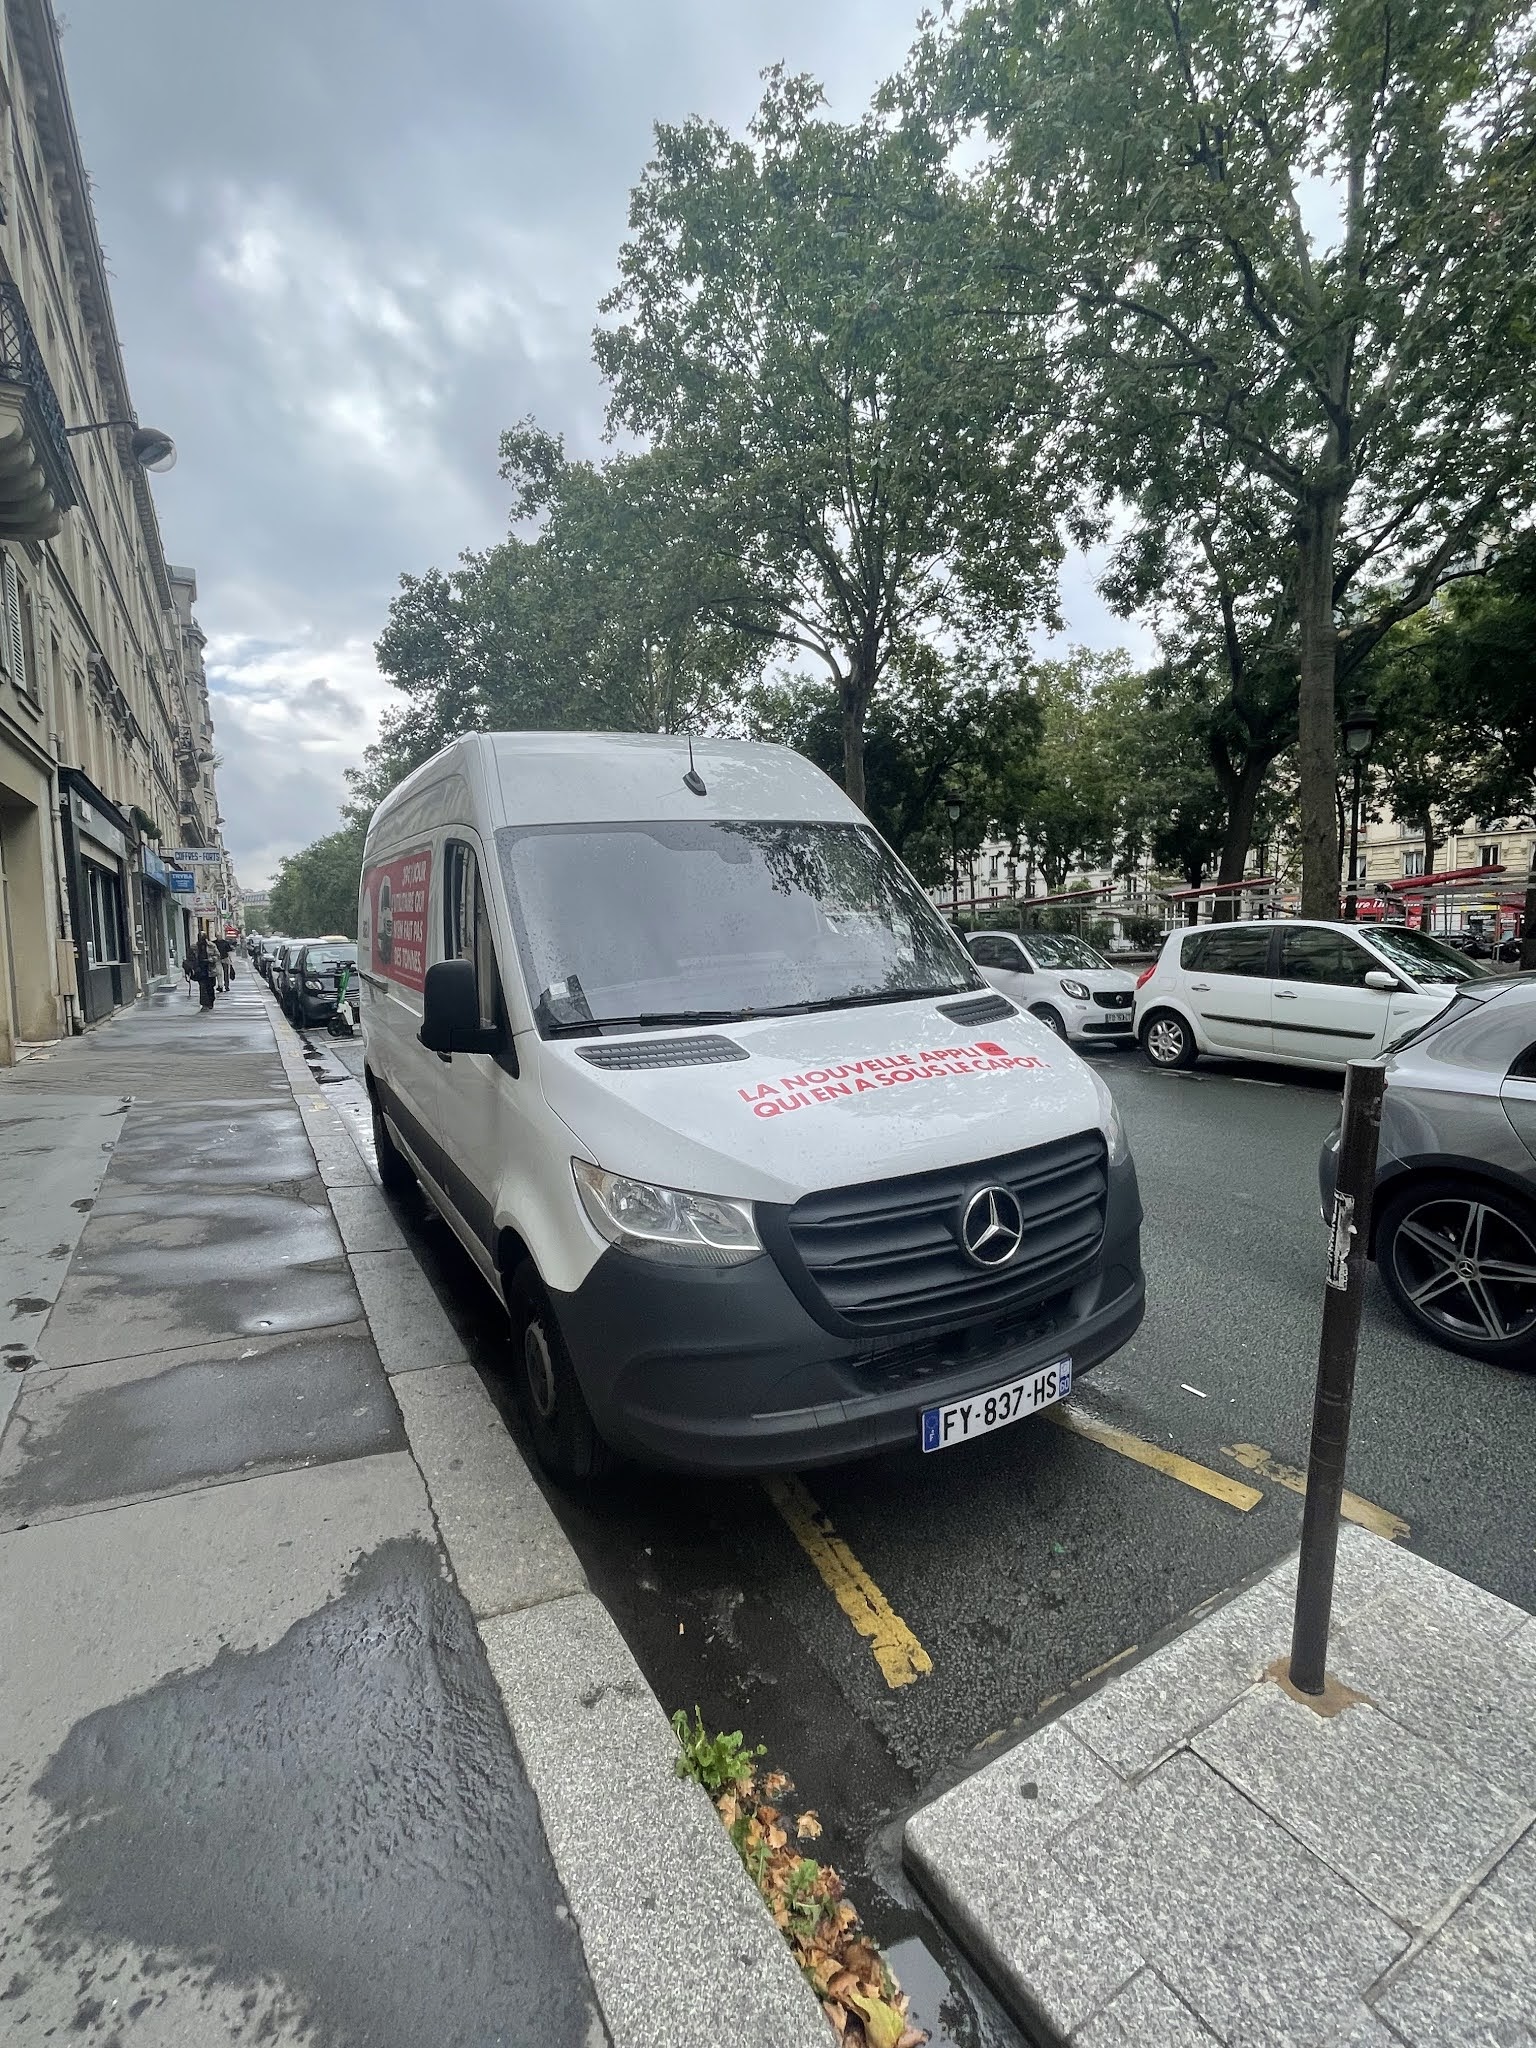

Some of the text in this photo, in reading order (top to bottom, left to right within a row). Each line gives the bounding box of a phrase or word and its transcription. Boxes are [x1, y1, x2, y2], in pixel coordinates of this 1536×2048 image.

[413, 921, 423, 942] PAS
[737, 1045, 981, 1103] LA NOUVELLE APPLI
[752, 1055, 1052, 1118] QUI EN A SOUS LE CAPOT.
[943, 1371, 1057, 1441] FY-837-HS
